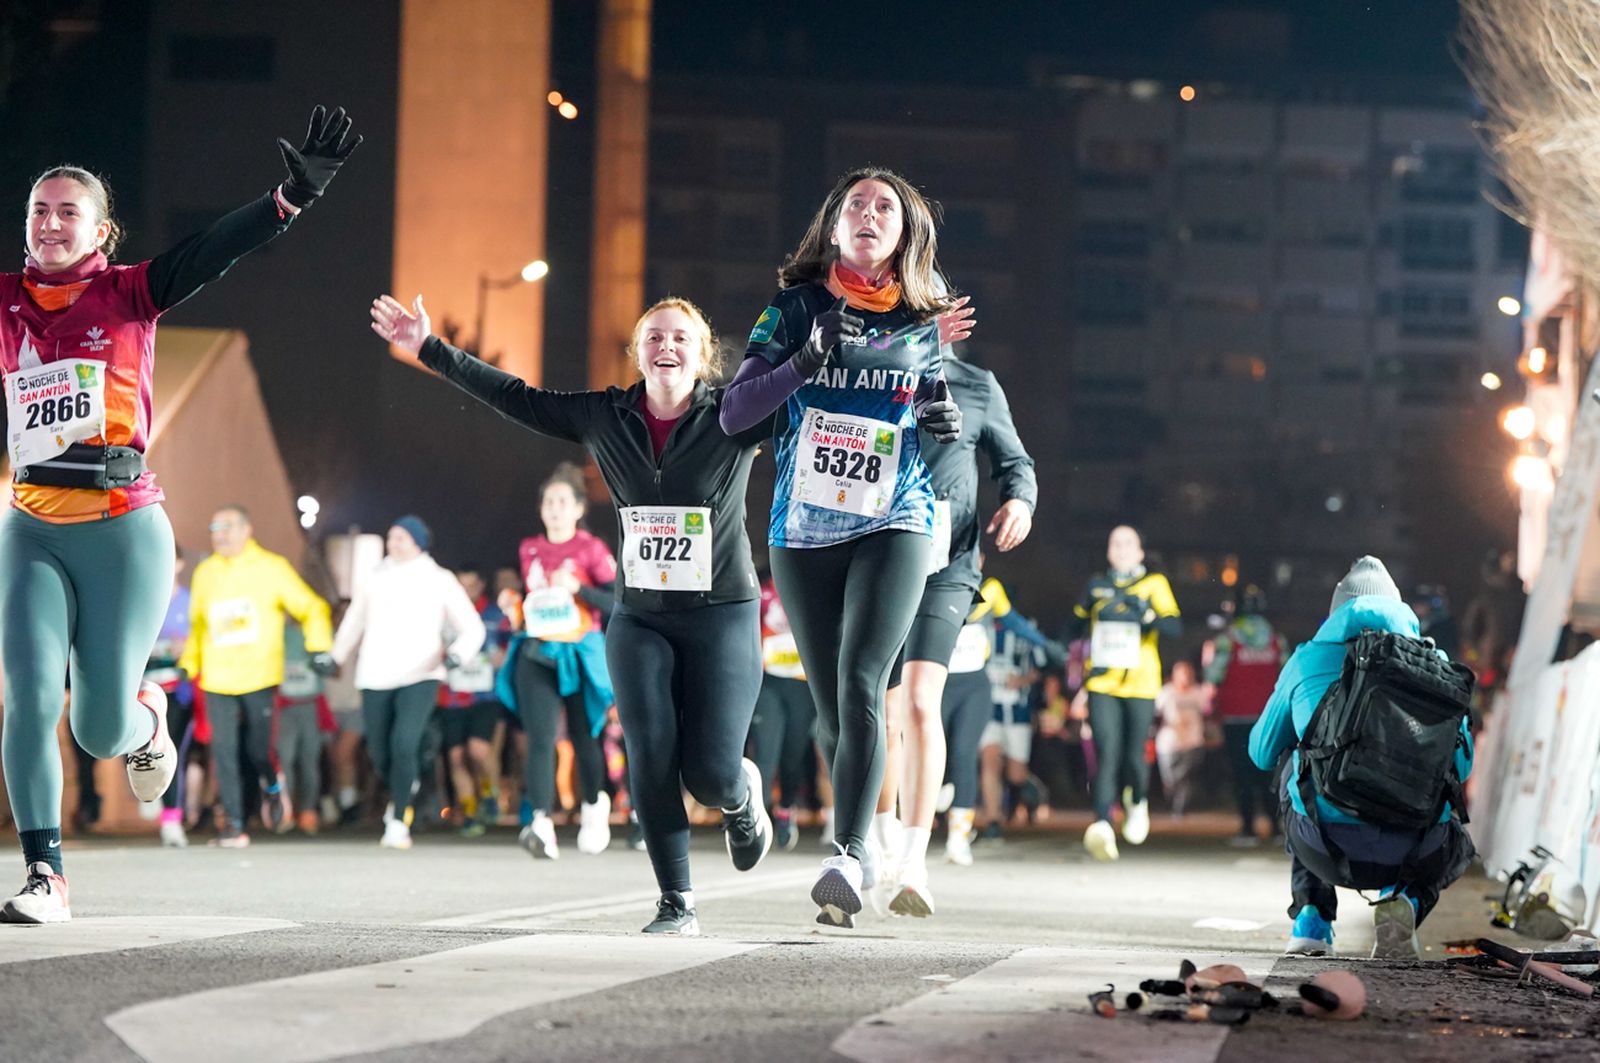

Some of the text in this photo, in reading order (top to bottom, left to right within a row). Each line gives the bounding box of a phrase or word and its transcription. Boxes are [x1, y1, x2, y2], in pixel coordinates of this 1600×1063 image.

[29, 374, 57, 389] NOCHE
[57, 371, 69, 382] DE
[19, 390, 39, 404] SAN
[39, 382, 71, 399] ANTÓN
[25, 392, 91, 430] 2866
[823, 423, 854, 435] NOCHE
[855, 427, 868, 438] DE
[811, 432, 831, 445] SAN
[832, 435, 866, 450] ANTÓN
[813, 446, 882, 484] 5328
[835, 480, 852, 488] Celia
[666, 516, 677, 524] DE
[640, 537, 692, 561] 6722
